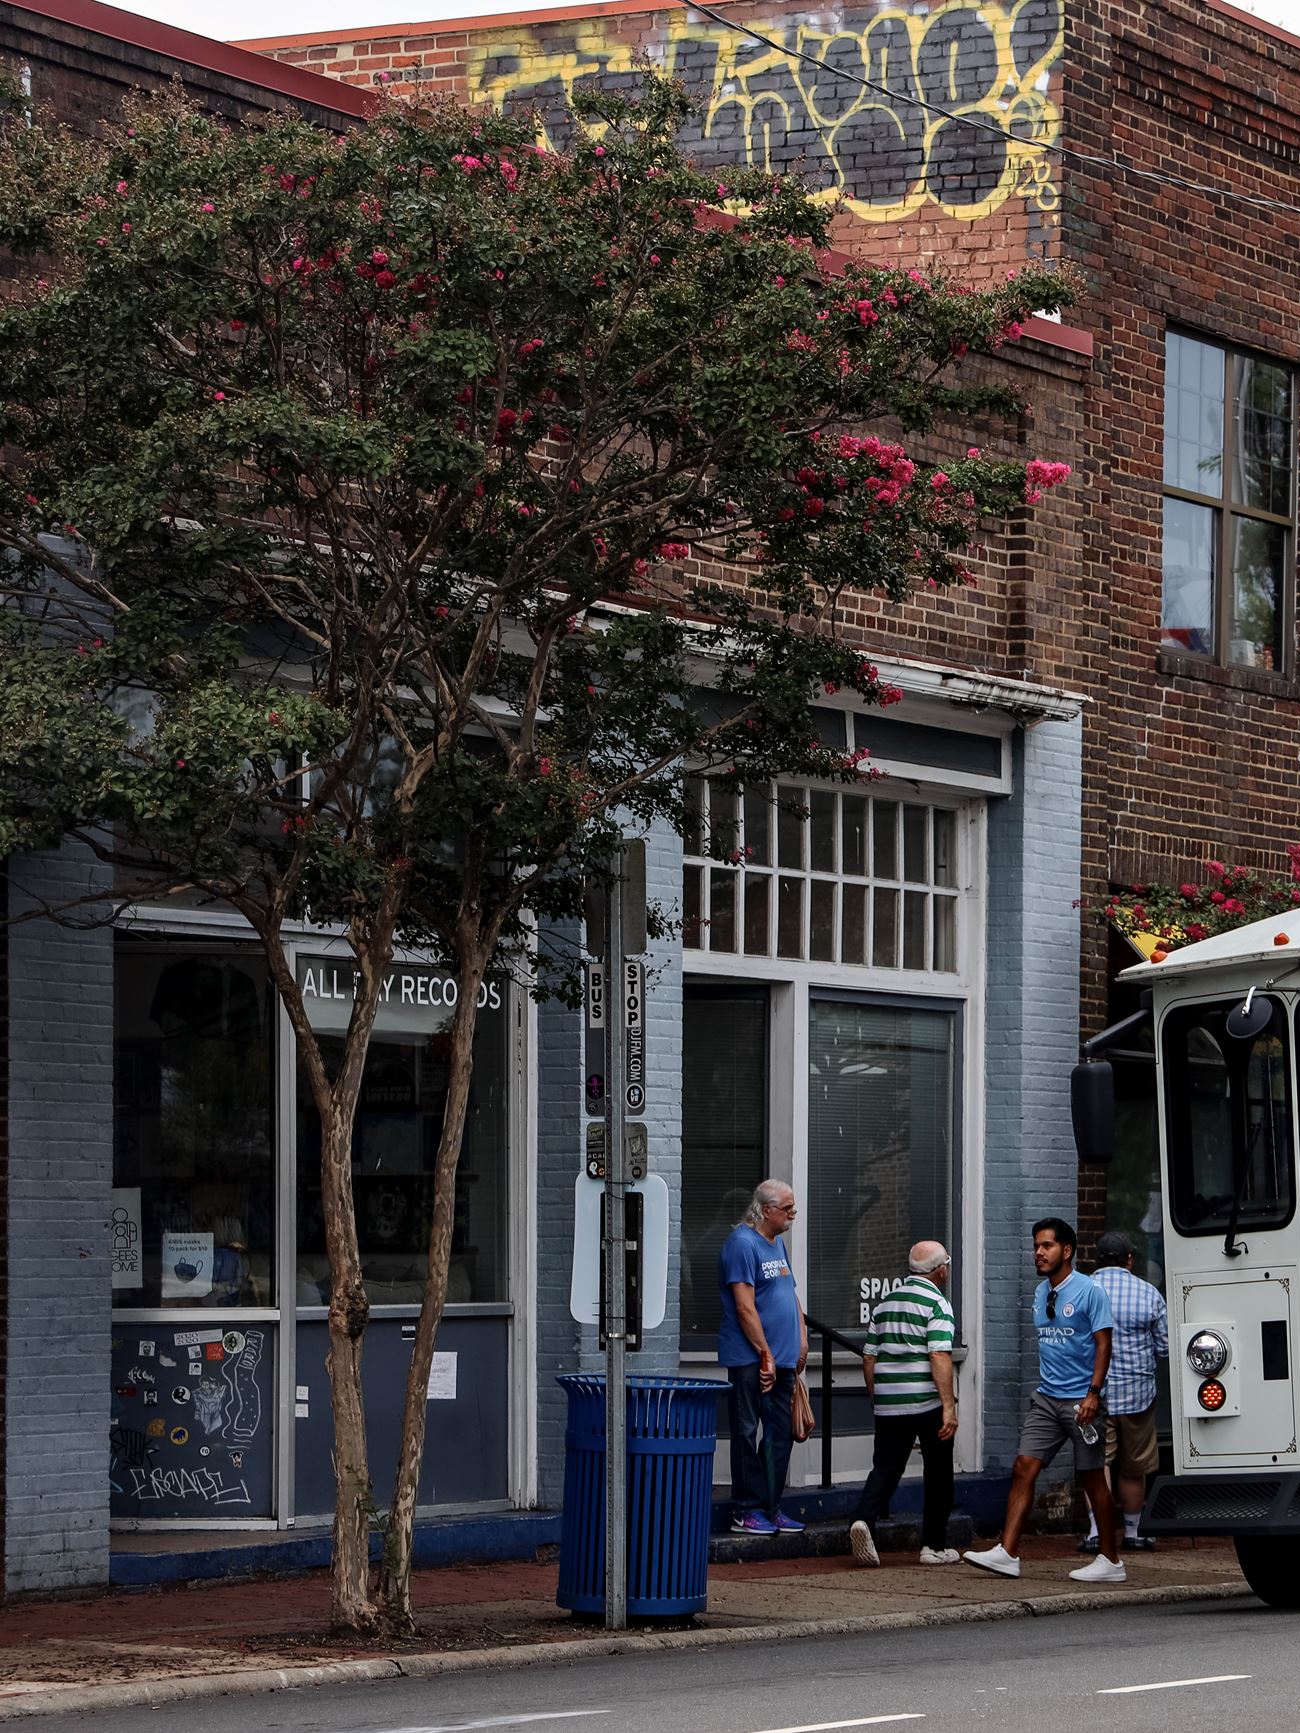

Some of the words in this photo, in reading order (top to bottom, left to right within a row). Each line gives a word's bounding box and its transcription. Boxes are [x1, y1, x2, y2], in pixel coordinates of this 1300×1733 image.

[301, 967, 346, 999] ALL
[401, 975, 501, 1010] RECODS
[591, 972, 602, 1019] BUS
[626, 964, 639, 1026] STOP
[630, 1028, 642, 1081] DJFM.COM
[111, 1250, 138, 1261] GEES
[111, 1262, 139, 1272] OME
[1038, 1327, 1075, 1336] TIHAD
